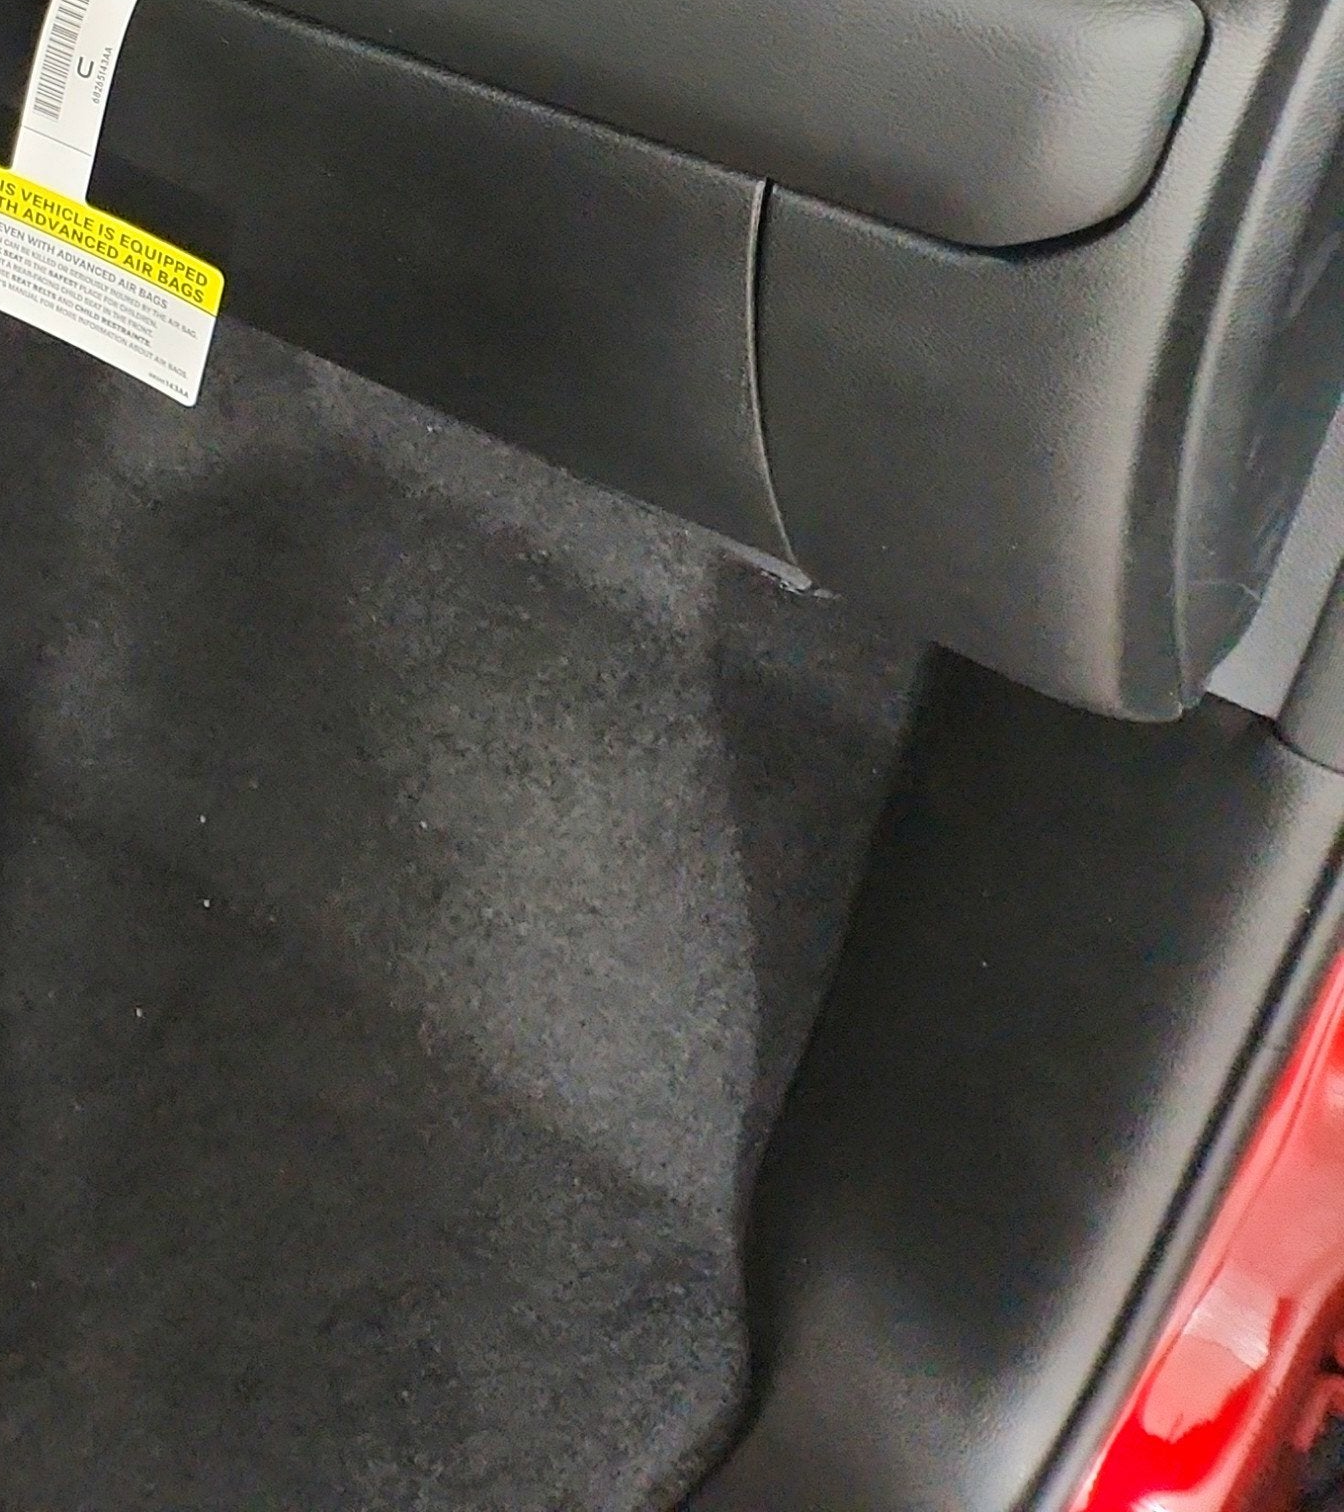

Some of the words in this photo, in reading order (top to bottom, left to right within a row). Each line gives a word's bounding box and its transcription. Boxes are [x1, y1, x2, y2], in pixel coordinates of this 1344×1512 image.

[77, 57, 96, 79] U
[20, 188, 94, 232] VEHICLE
[98, 223, 115, 241] IS
[119, 233, 208, 288] EQUIPPED
[22, 206, 119, 260] ADVANCED
[122, 252, 153, 277] AIR
[157, 269, 204, 304] BAGS
[27, 235, 55, 254] WITH
[57, 248, 116, 283] ADVANCED
[118, 277, 137, 293] AIR
[138, 287, 168, 309] BAGS
